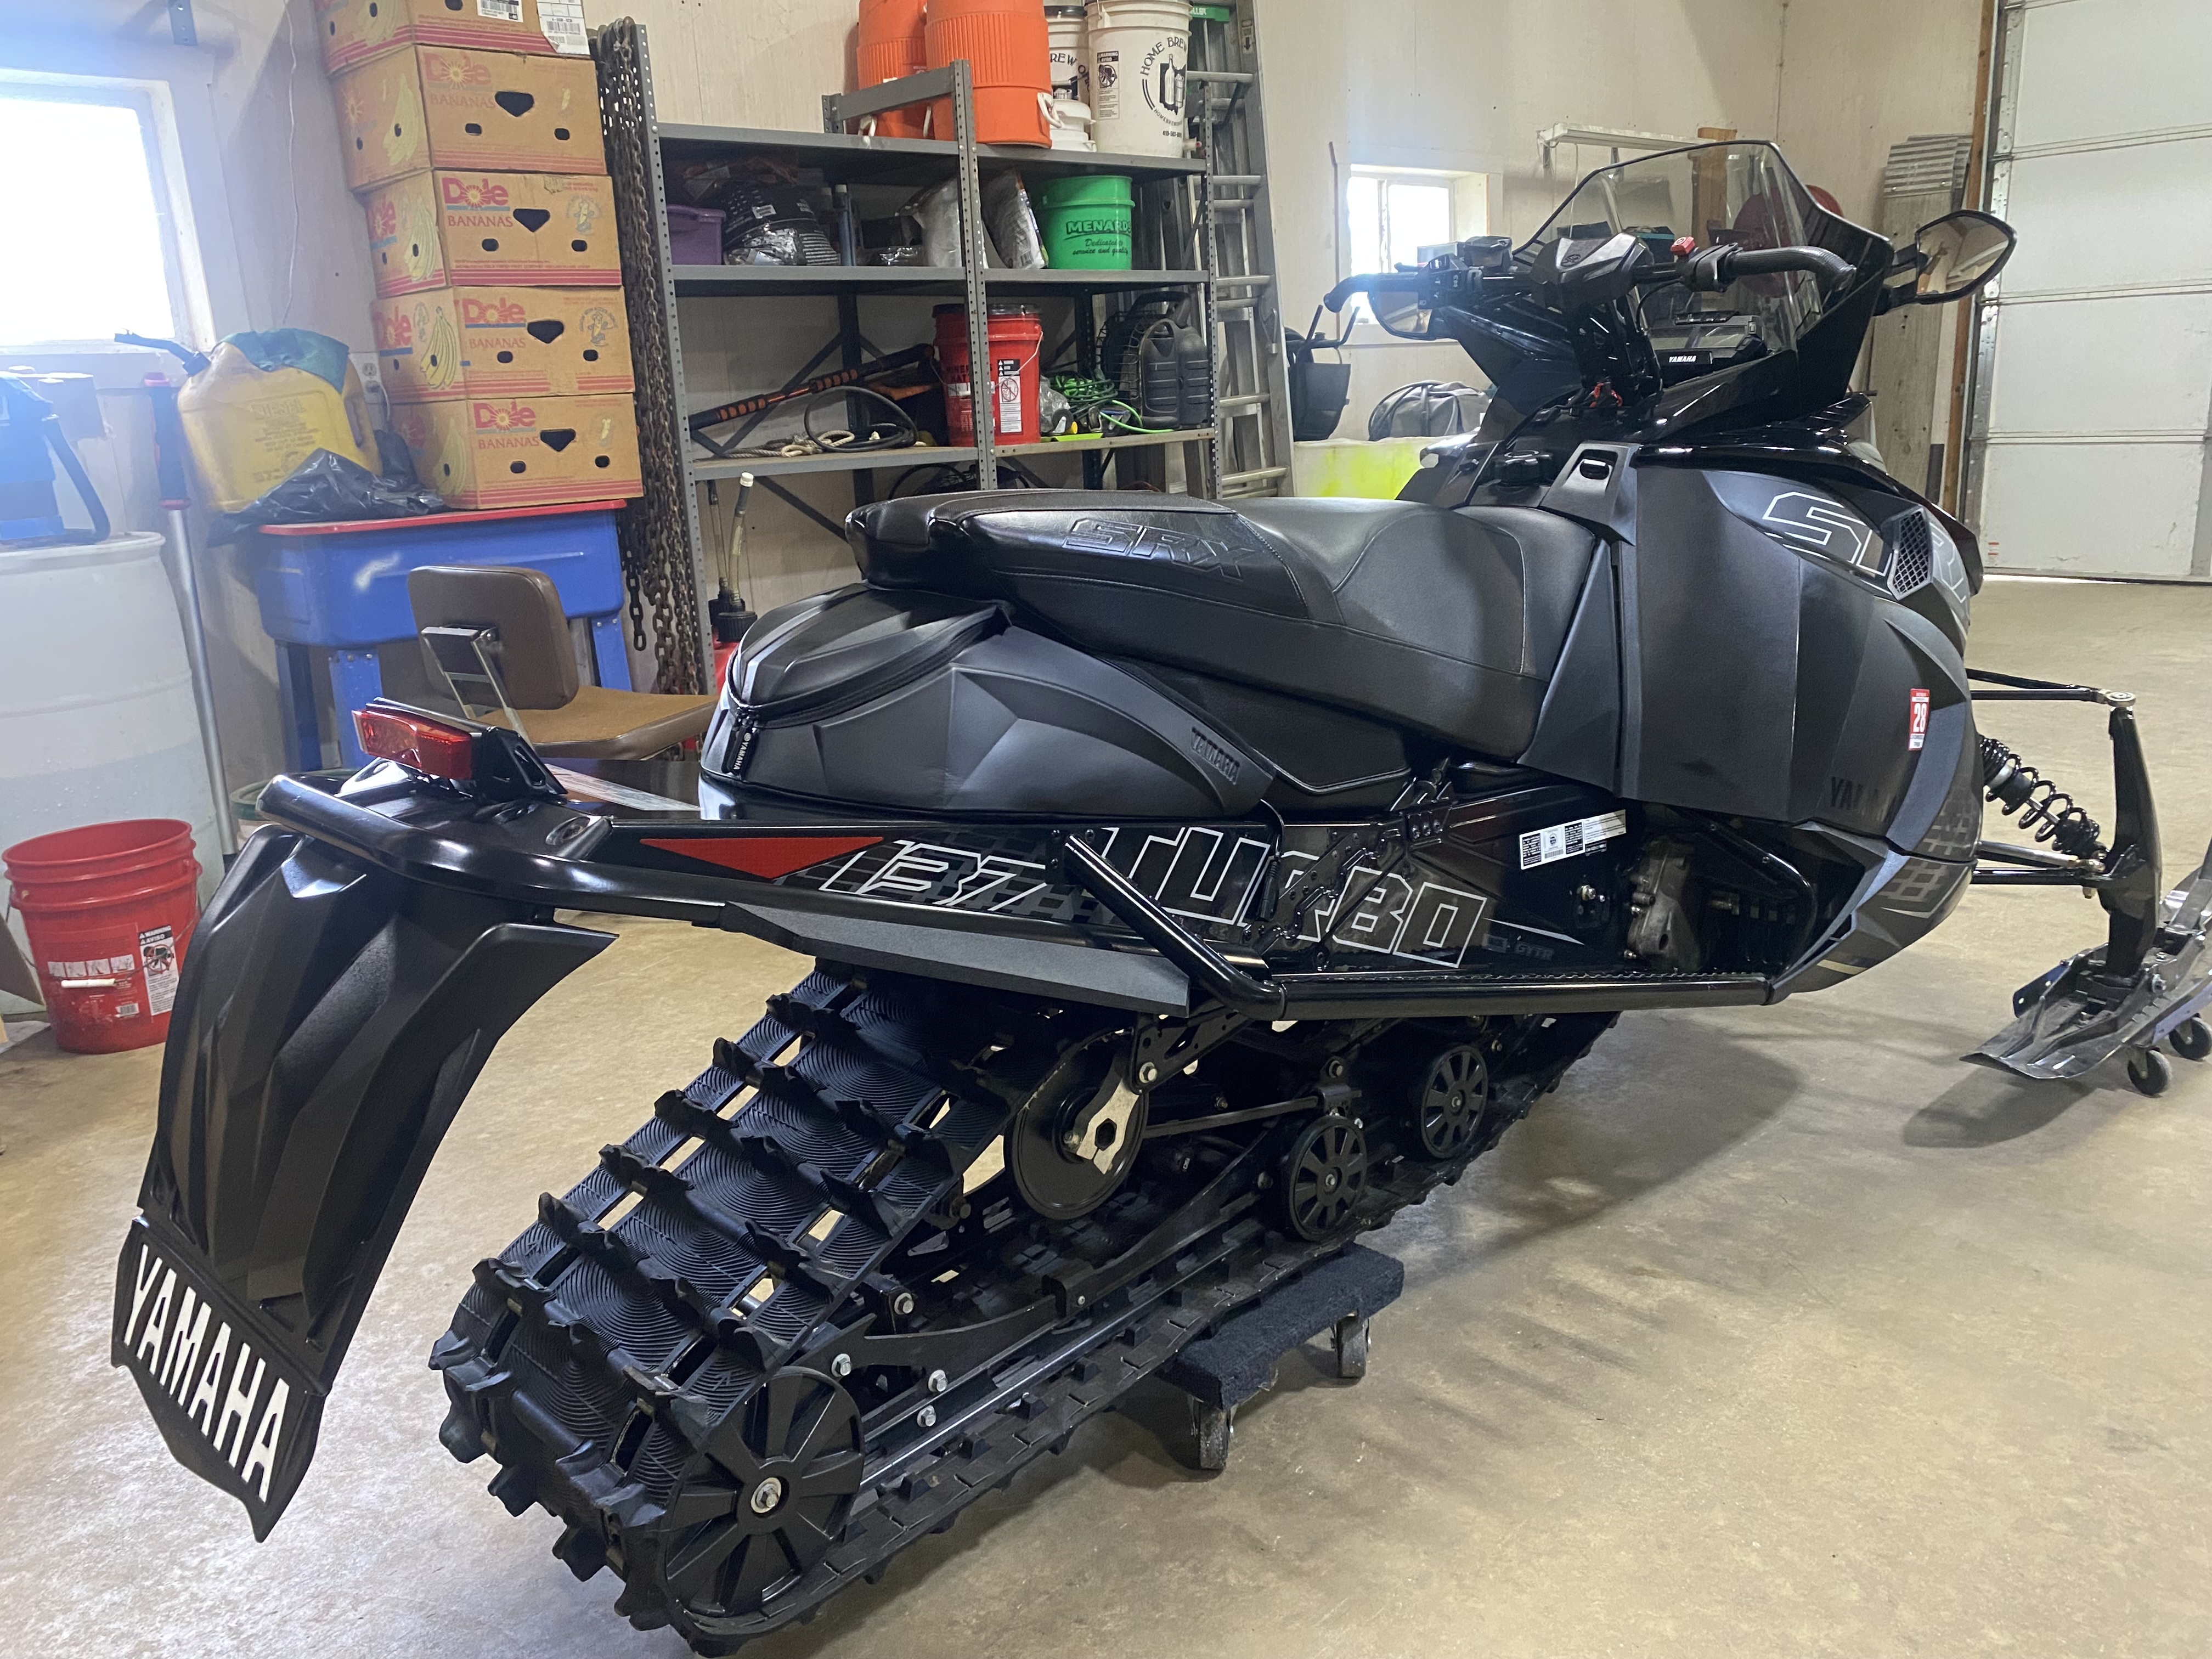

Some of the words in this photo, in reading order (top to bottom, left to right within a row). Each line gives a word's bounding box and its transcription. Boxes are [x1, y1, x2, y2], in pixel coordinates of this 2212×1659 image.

[423, 50, 492, 86] Dole
[1050, 53, 1078, 66] REW
[1140, 42, 1165, 76] HOME
[431, 93, 496, 109] BANANAS
[442, 177, 509, 207] Dole
[447, 215, 514, 227] BANANAS
[1085, 238, 1116, 246] Dedicated
[462, 297, 526, 324] Dole
[469, 337, 526, 348] BANANAS
[473, 401, 536, 431] Dole
[478, 437, 540, 449] BANANAS
[1913, 703, 1927, 732] 28
[733, 742, 748, 769] YAMAHA
[124, 1244, 289, 1503] YAMAHA
